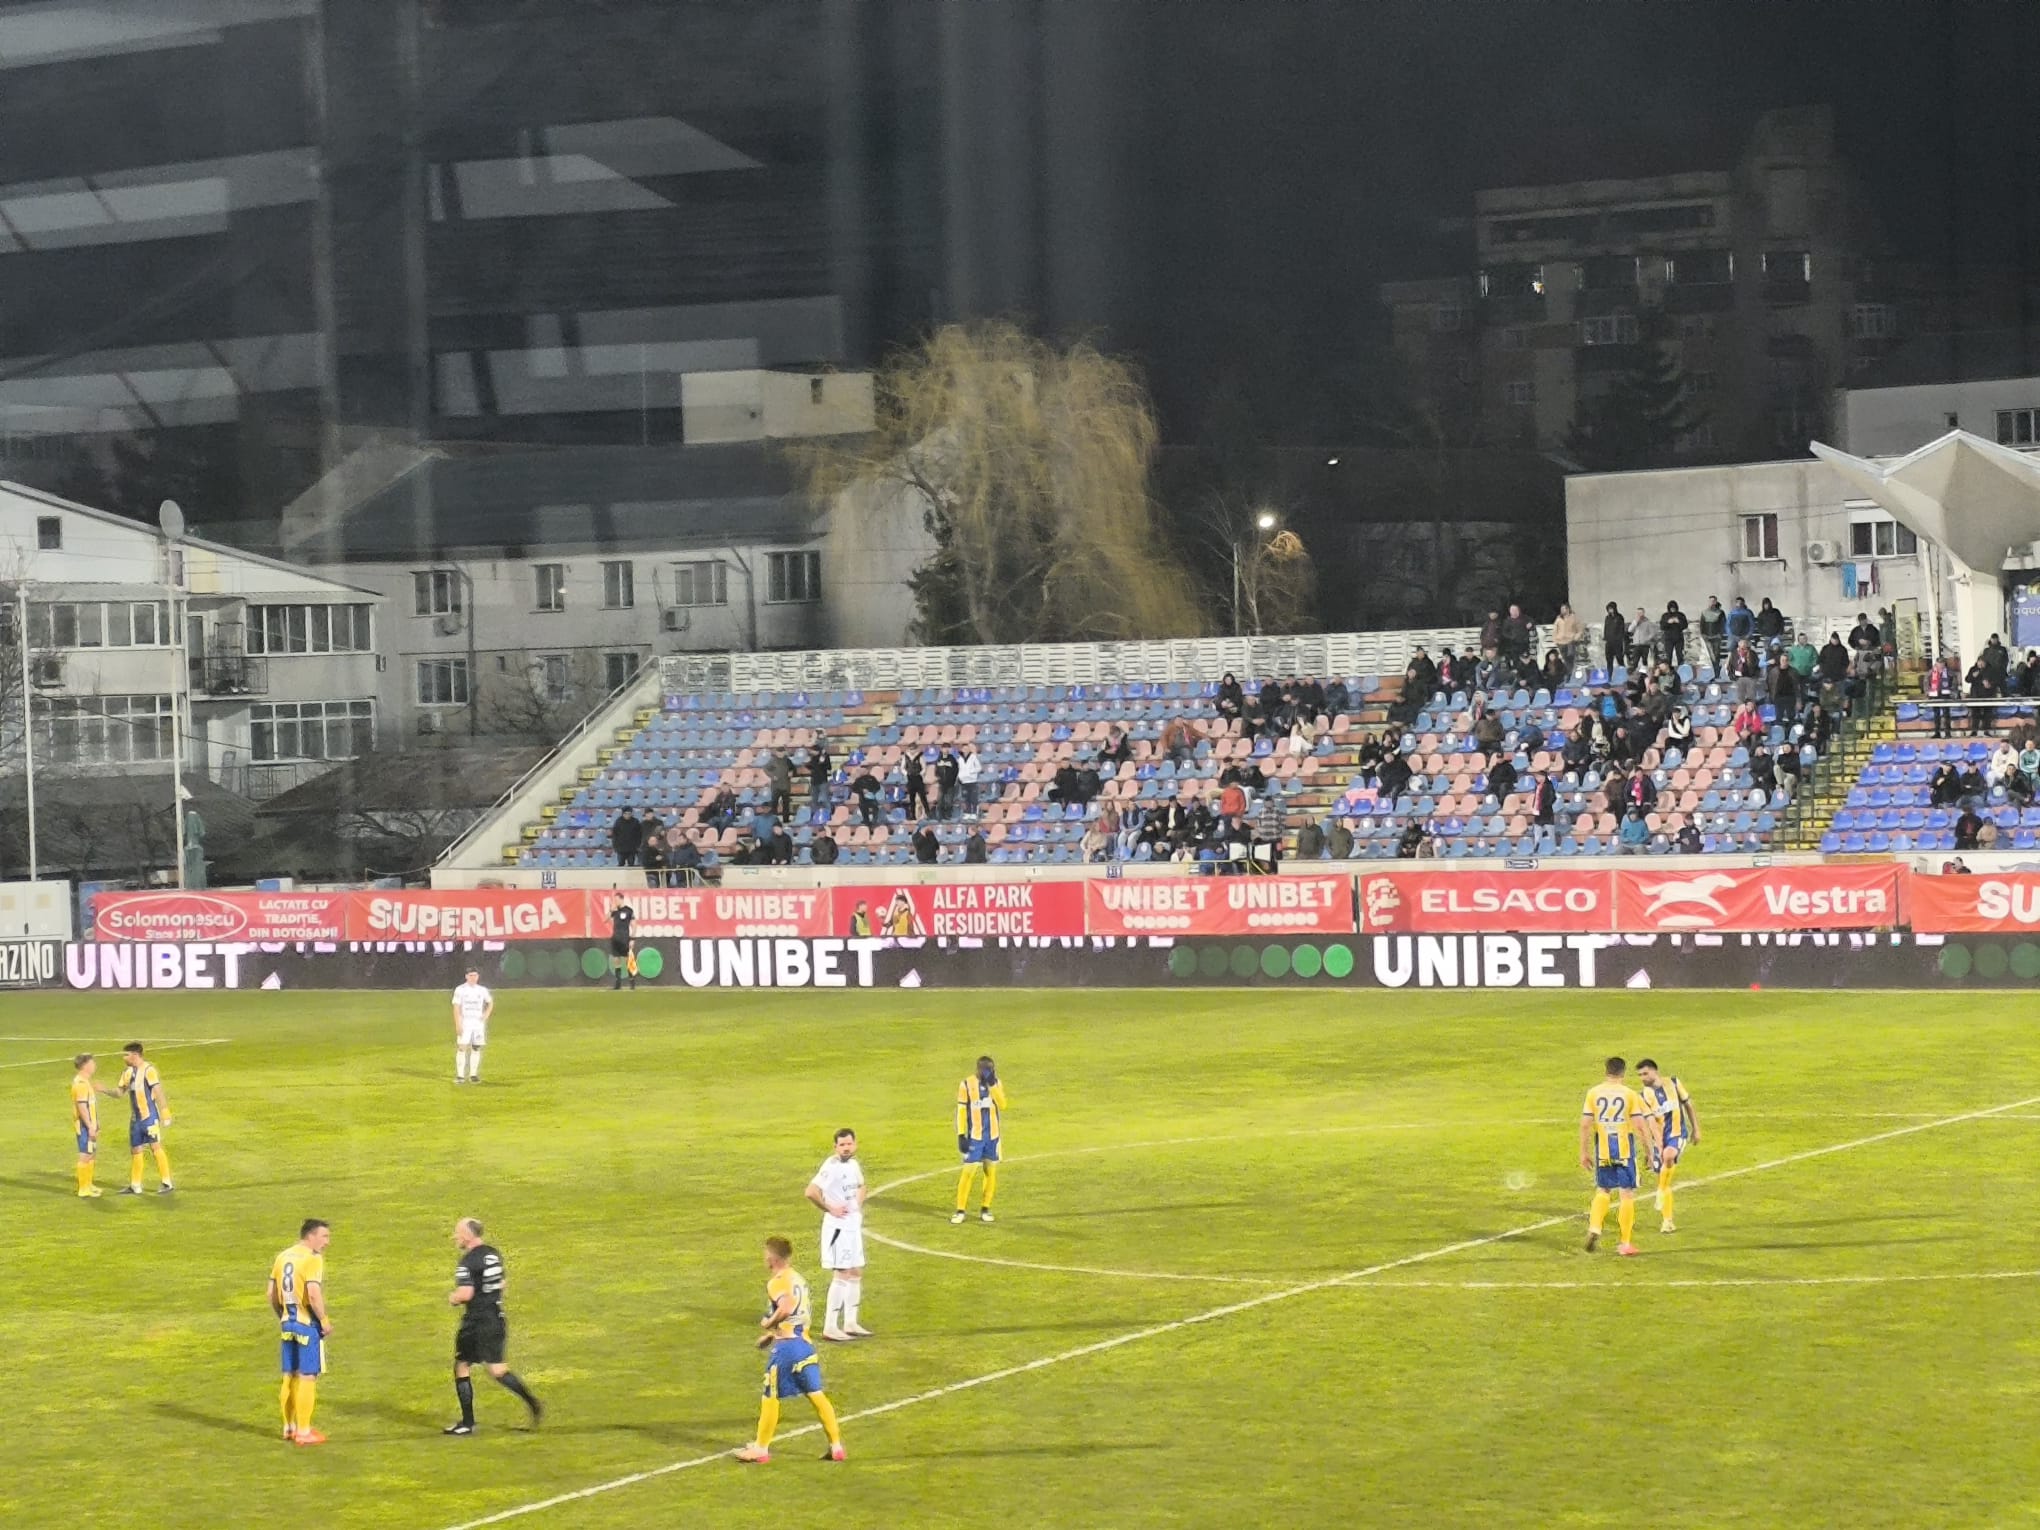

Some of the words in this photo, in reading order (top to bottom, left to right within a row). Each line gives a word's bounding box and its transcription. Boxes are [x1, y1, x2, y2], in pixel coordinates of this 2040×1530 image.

[259, 900, 309, 910] LACTATE
[311, 900, 329, 910] CU
[716, 895, 816, 920] UNIBET
[933, 887, 978, 909] ALFA
[985, 885, 1033, 908] PARK
[1102, 884, 1210, 911] UNIBET
[1228, 881, 1337, 909] UNIBET
[1421, 888, 1597, 913] ELSACO
[1764, 884, 1887, 915] Vestra
[110, 911, 235, 928] Solomonescu
[367, 897, 567, 936] SUPERLIGA
[933, 912, 1034, 936] RESIDENCE
[145, 929, 173, 939] Since
[249, 928, 270, 938] DIN
[66, 943, 248, 989] UNIBET
[680, 938, 884, 987] UNIBET
[1373, 935, 1608, 987] UNIBET
[1597, 1097, 1625, 1122] 22
[282, 1262, 294, 1292] 8
